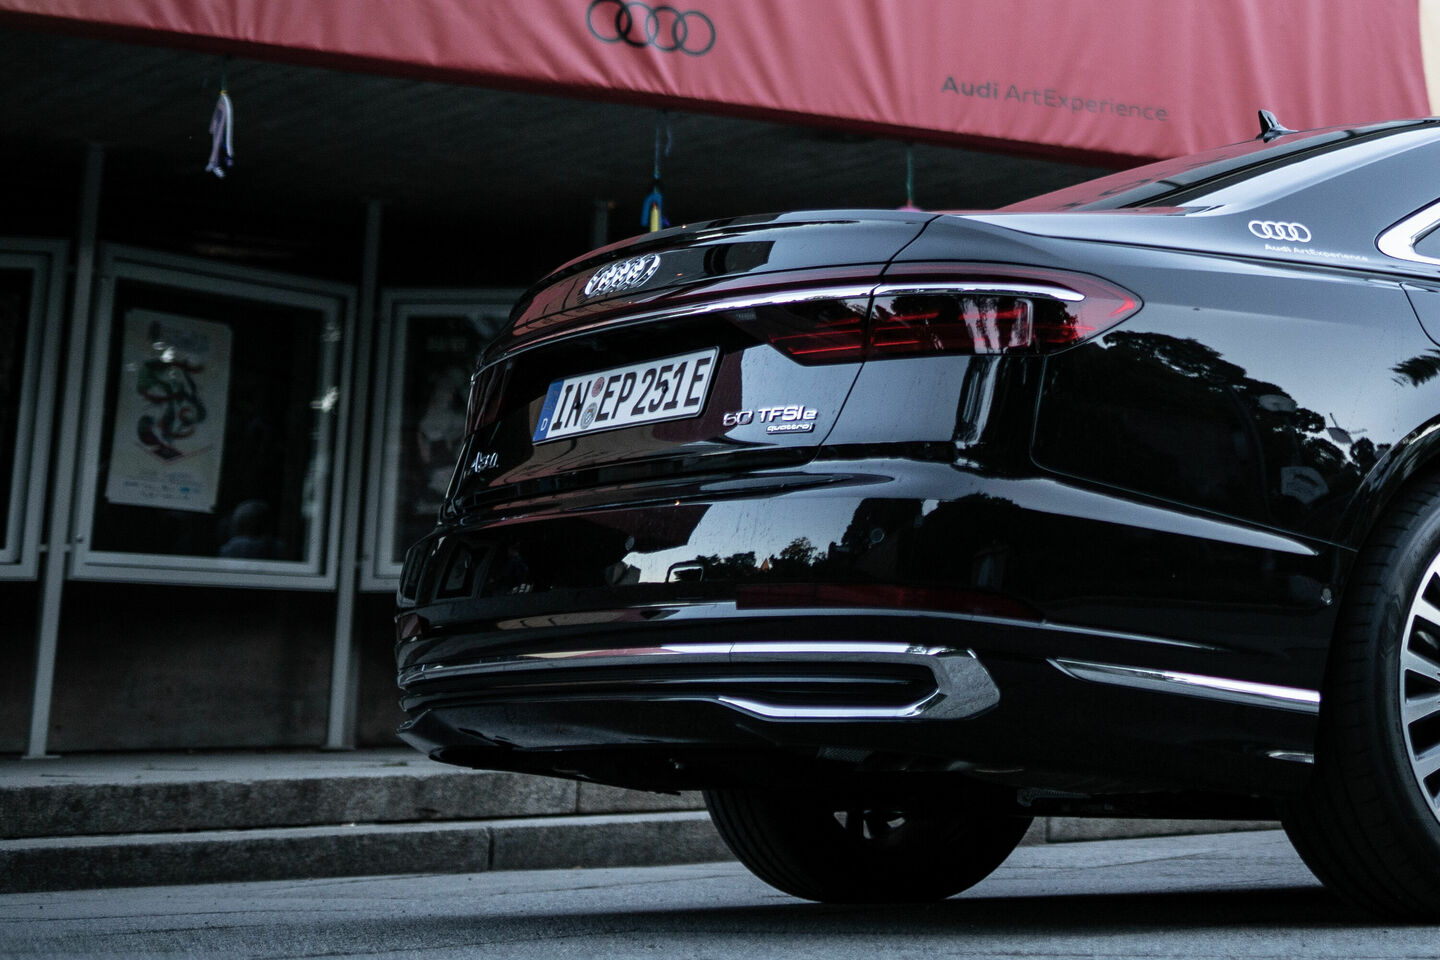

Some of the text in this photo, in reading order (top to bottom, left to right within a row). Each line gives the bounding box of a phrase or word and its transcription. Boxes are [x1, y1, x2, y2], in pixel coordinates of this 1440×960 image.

[941, 76, 1168, 122] Audi ArtExperience
[722, 410, 754, 427] 60
